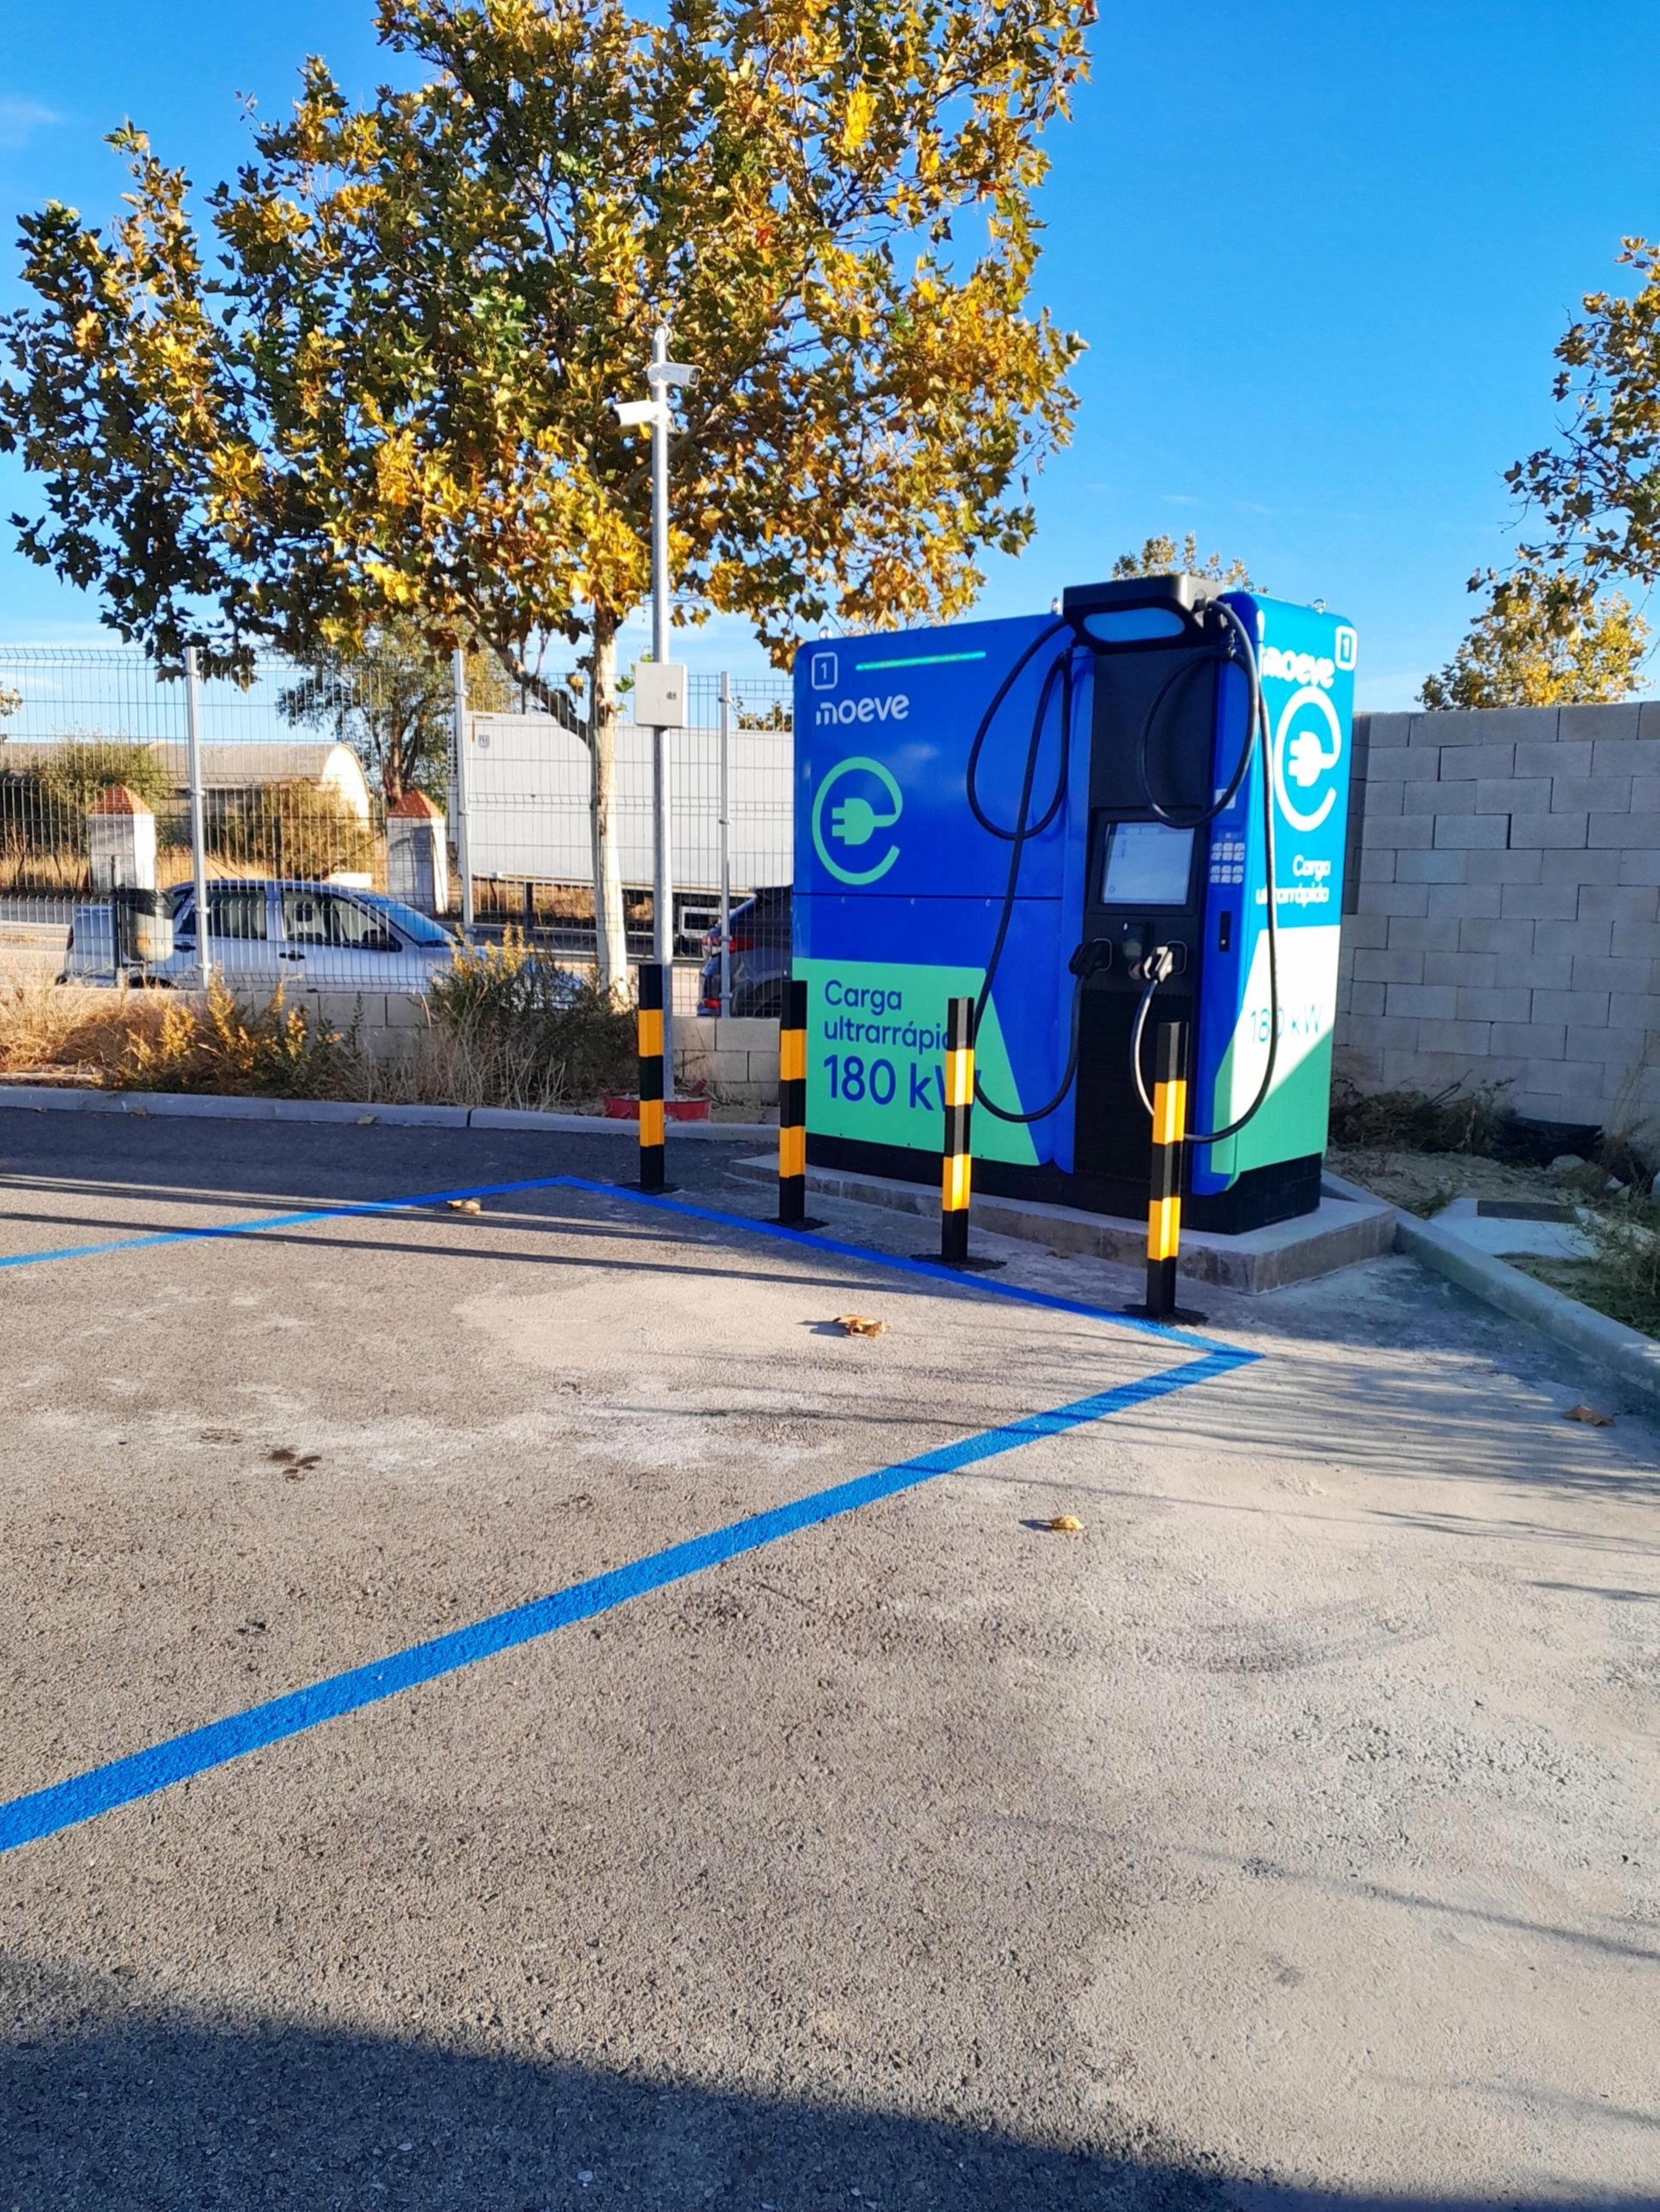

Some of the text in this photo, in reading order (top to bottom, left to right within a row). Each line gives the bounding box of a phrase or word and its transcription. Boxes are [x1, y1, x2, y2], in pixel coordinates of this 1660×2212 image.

[821, 661, 827, 680] 1
[815, 694, 910, 726] moeve
[1292, 854, 1332, 882] Carga
[824, 979, 902, 1016] Carga
[823, 1054, 896, 1106] 180
